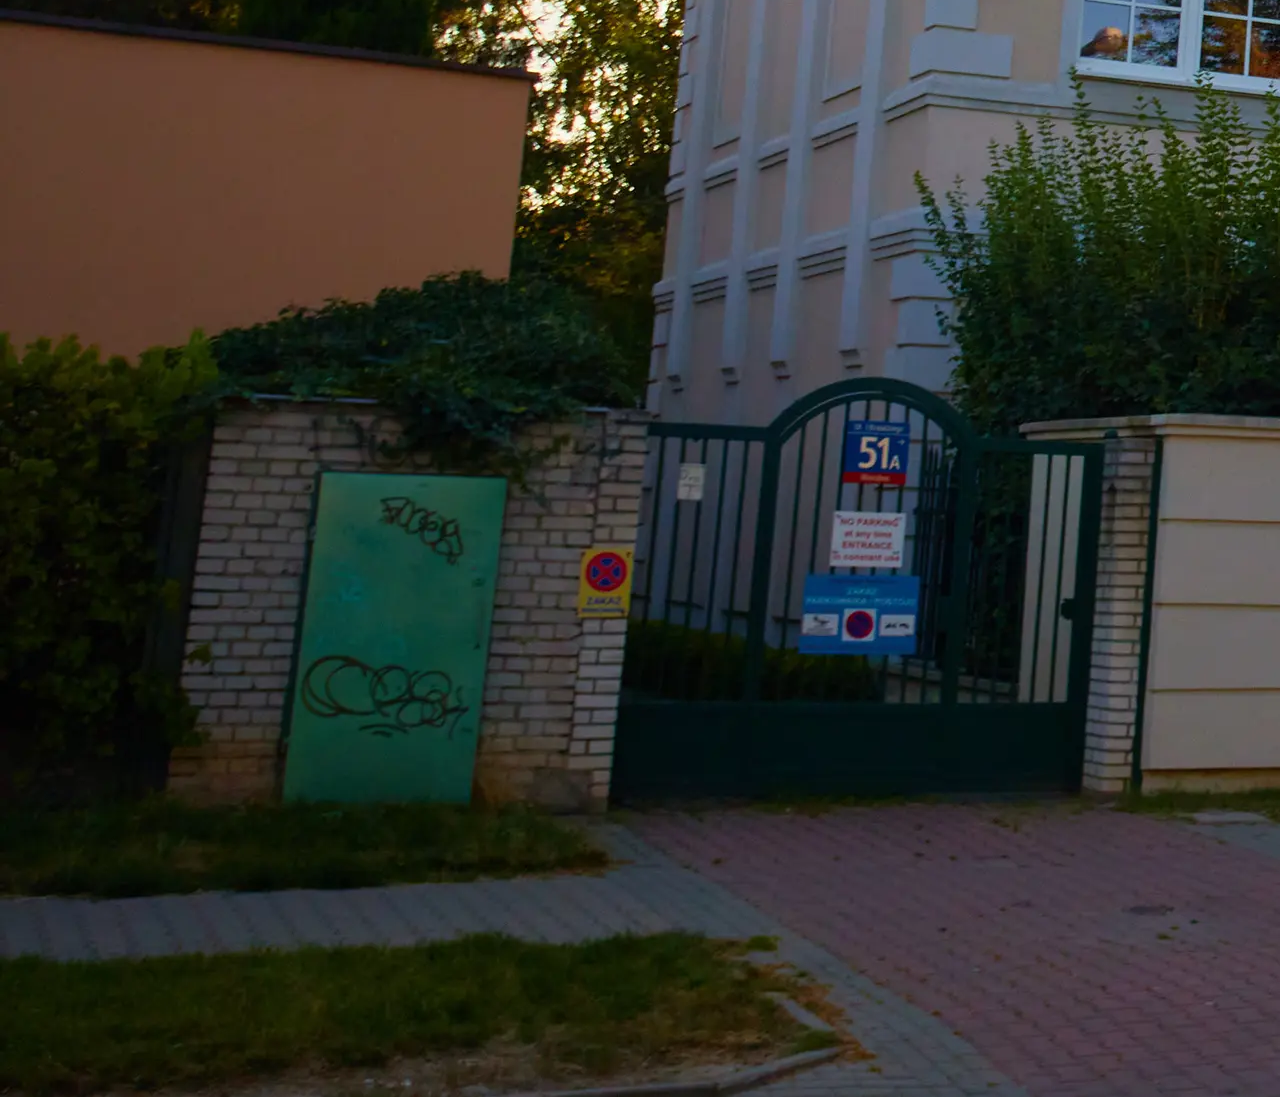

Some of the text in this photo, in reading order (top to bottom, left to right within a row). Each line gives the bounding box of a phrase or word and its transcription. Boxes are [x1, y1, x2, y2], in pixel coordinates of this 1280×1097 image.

[840, 518, 899, 527] NO PARKING
[842, 541, 893, 550] ENTRANCE
